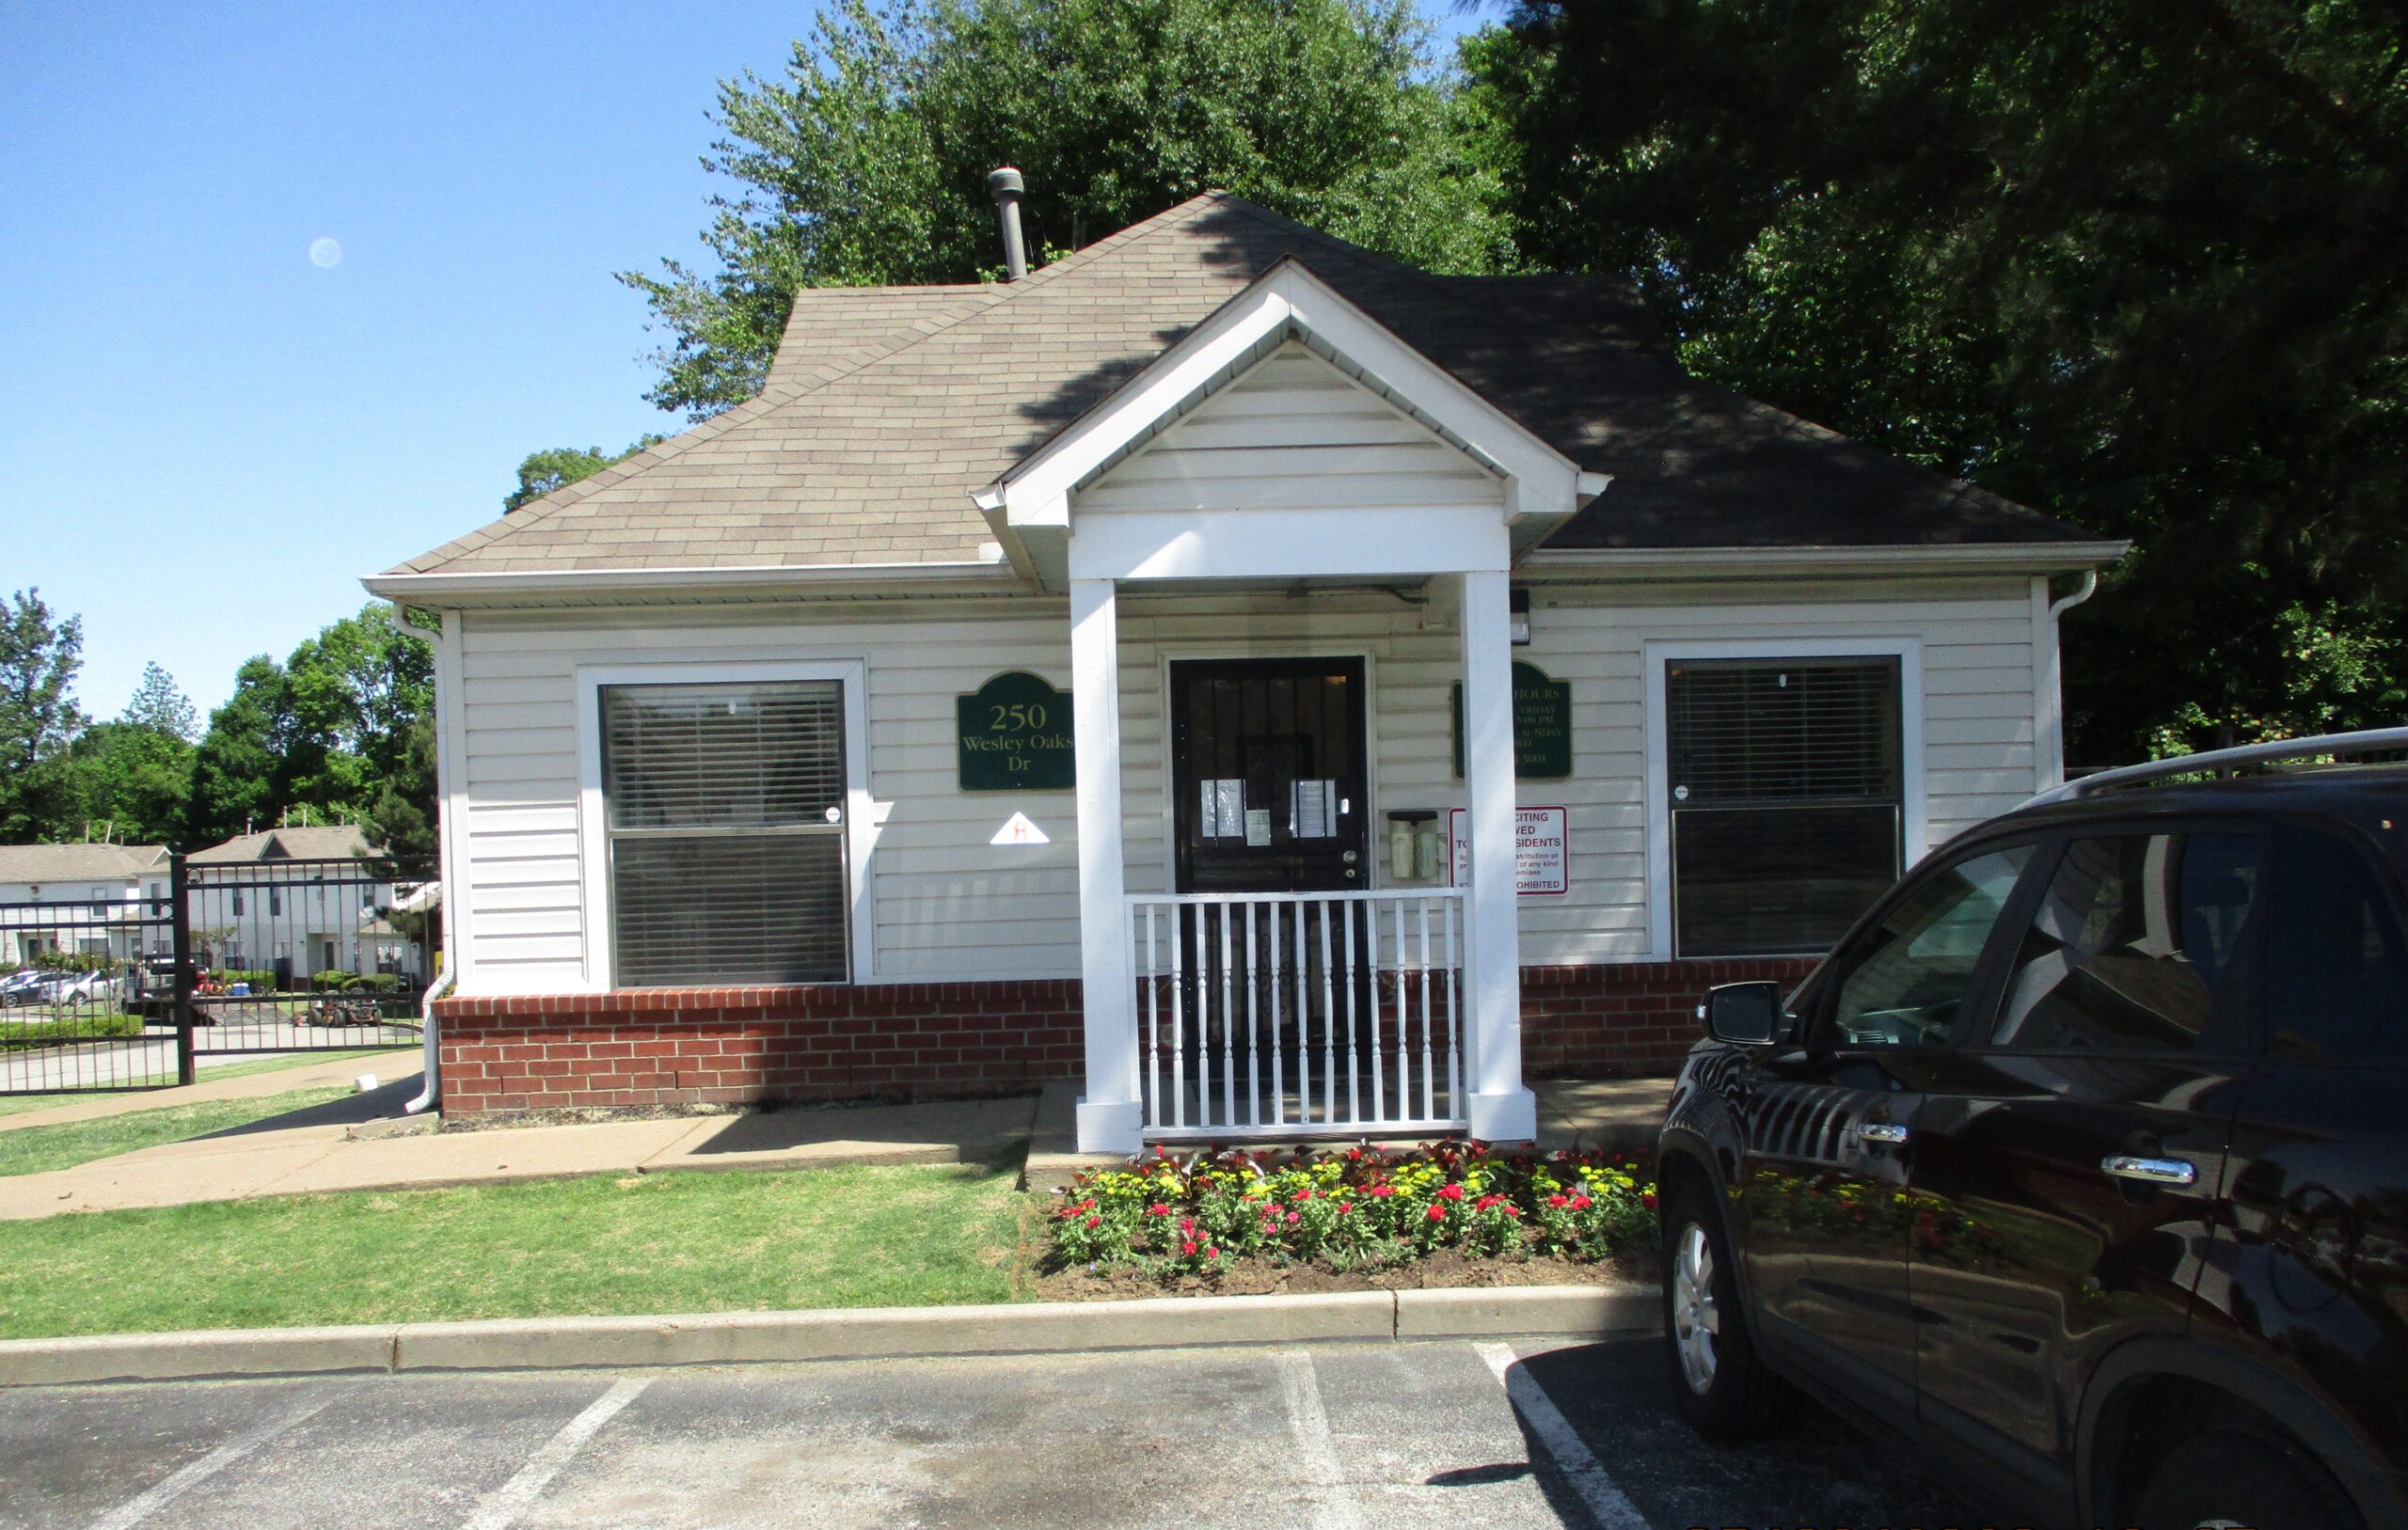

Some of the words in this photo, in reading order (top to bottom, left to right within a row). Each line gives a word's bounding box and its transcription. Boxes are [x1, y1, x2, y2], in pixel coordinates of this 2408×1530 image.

[990, 703, 1047, 732] 250
[963, 735, 1024, 754] Wesley
[1030, 734, 1073, 749] Oaks
[1008, 756, 1031, 771] Dr
